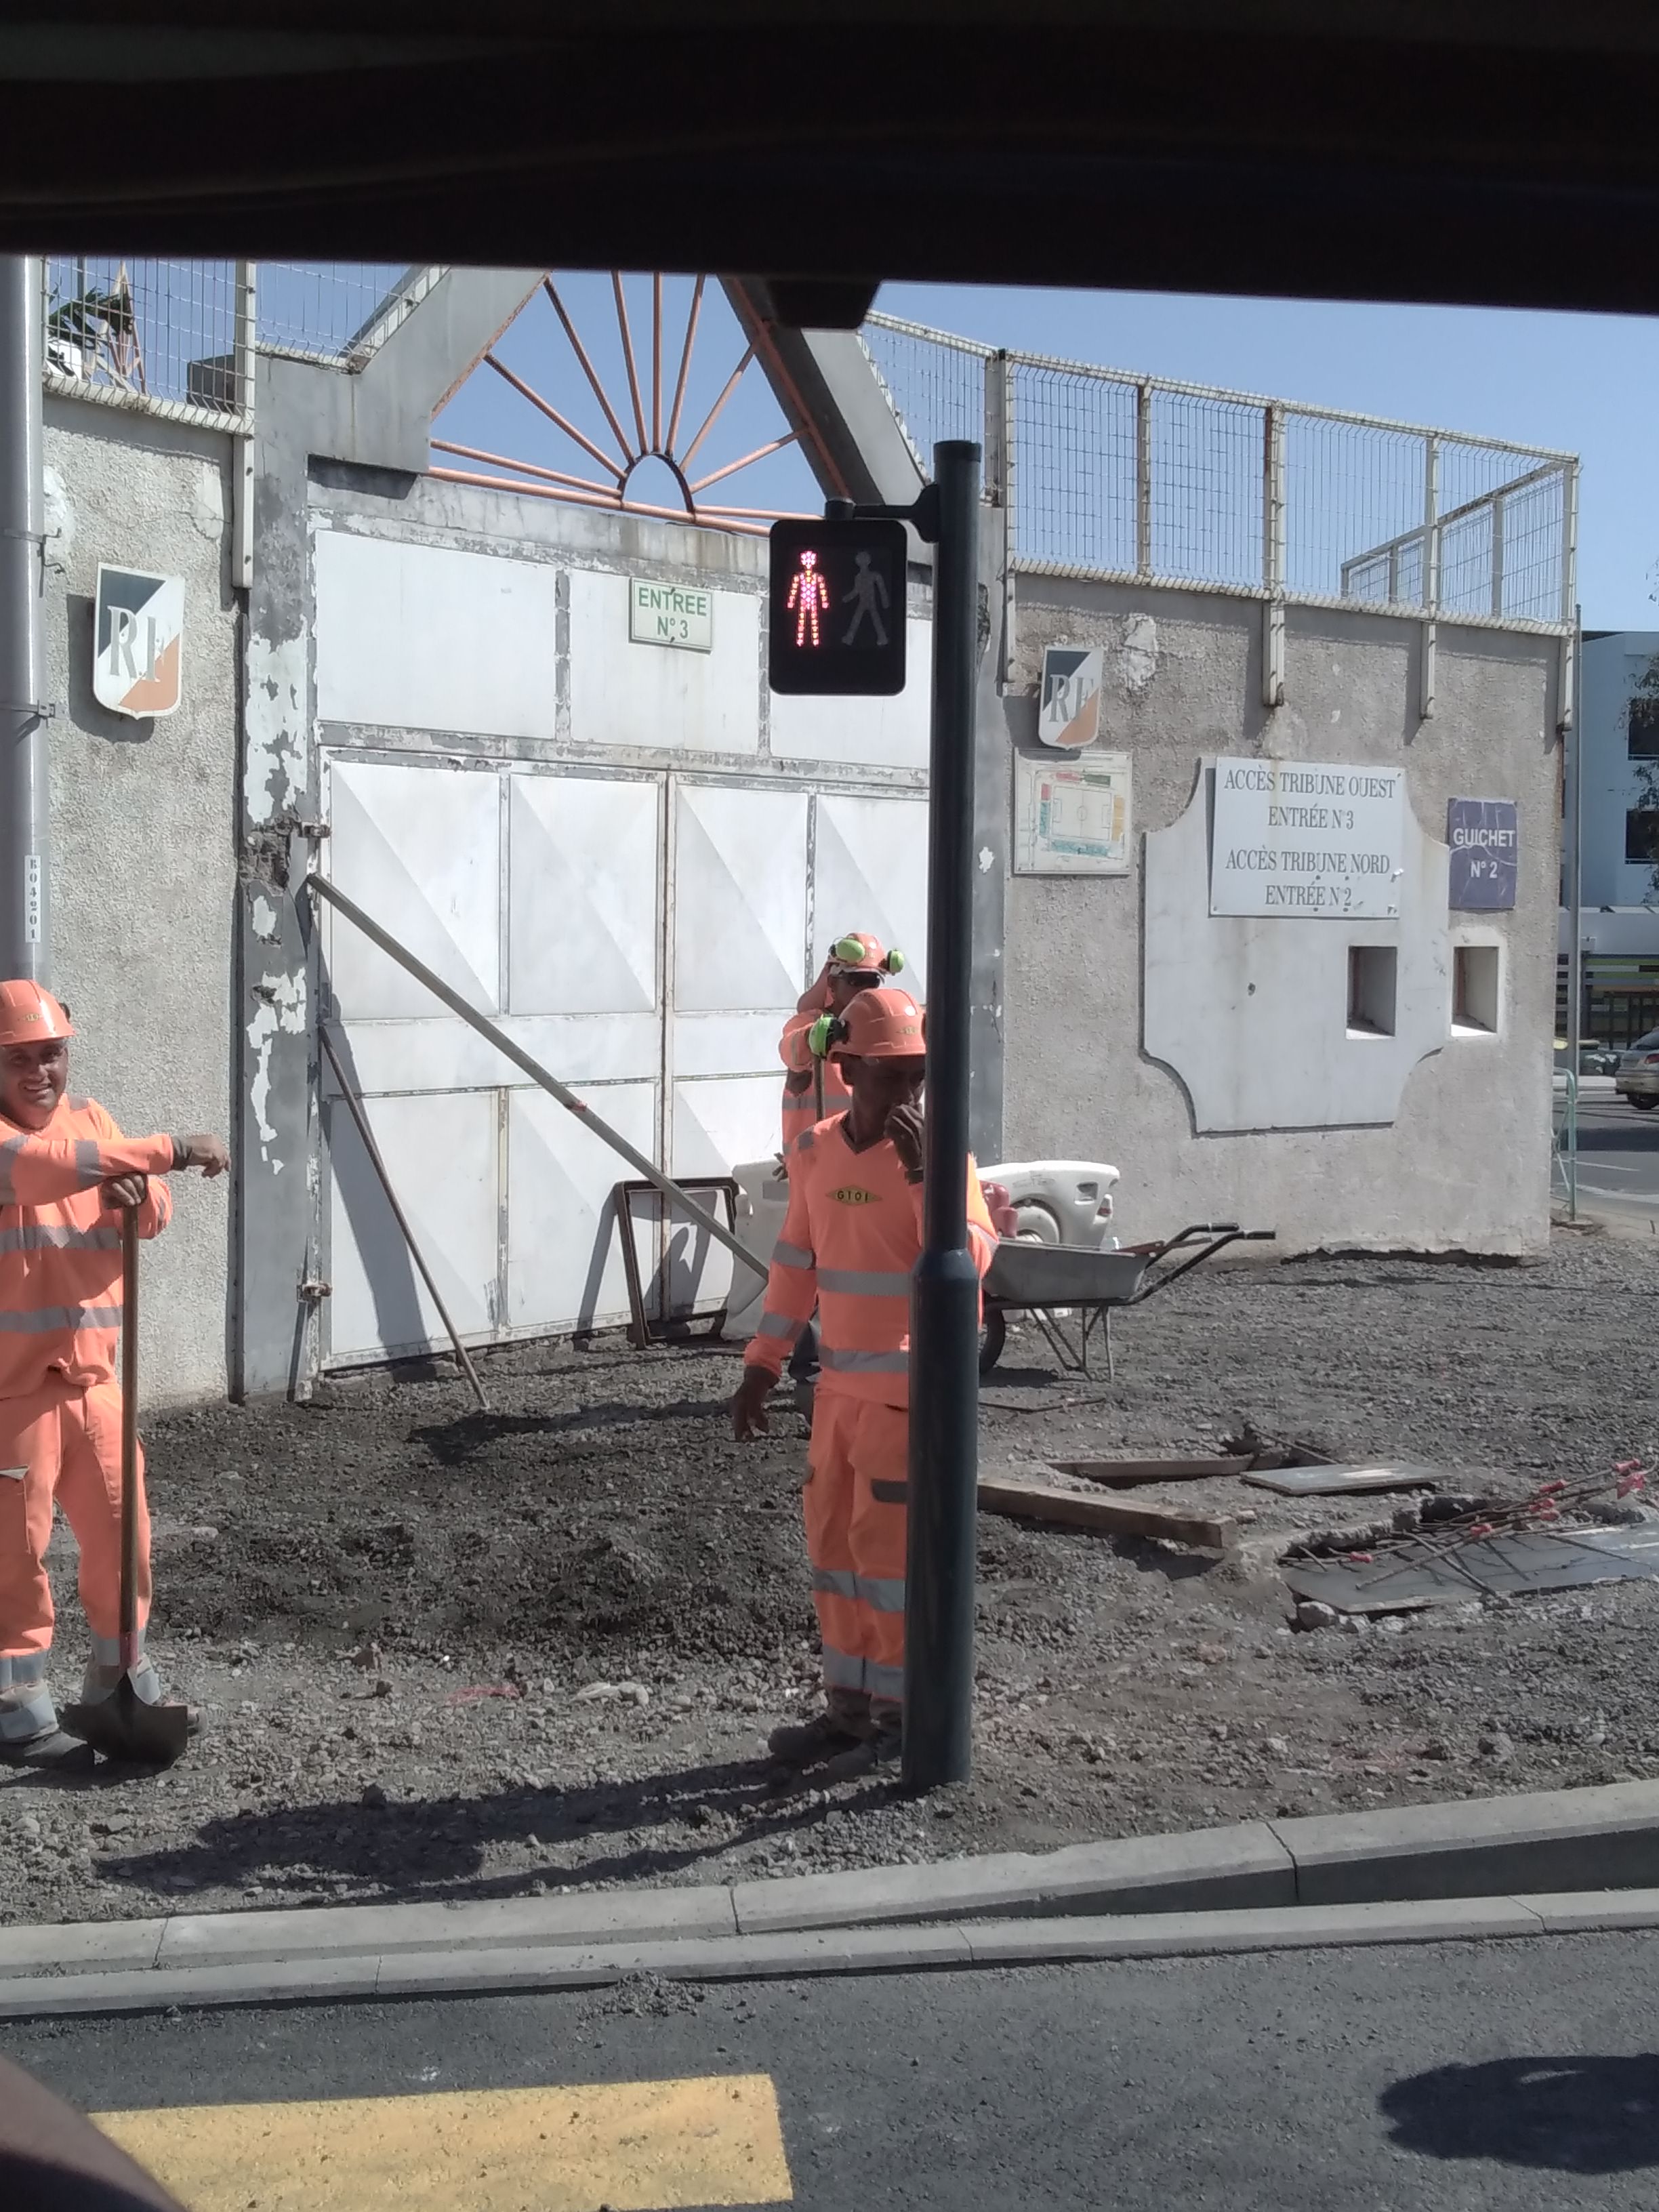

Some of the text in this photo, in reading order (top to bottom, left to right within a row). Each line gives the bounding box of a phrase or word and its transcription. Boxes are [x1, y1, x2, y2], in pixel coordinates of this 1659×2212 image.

[638, 587, 707, 617] ENTREE
[680, 619, 689, 639] 3
[1224, 765, 1396, 798] ACCÈS TRIBUNE OUEST
[1268, 803, 1328, 828] ENTRÉE
[1346, 811, 1353, 830] 3
[1453, 827, 1515, 847] GUICHET
[1225, 845, 1390, 874] ACCÈS TRIBUNE NORD
[1489, 861, 1498, 878] 2
[1265, 881, 1325, 906] ENTRÉE
[1344, 887, 1351, 906] 2
